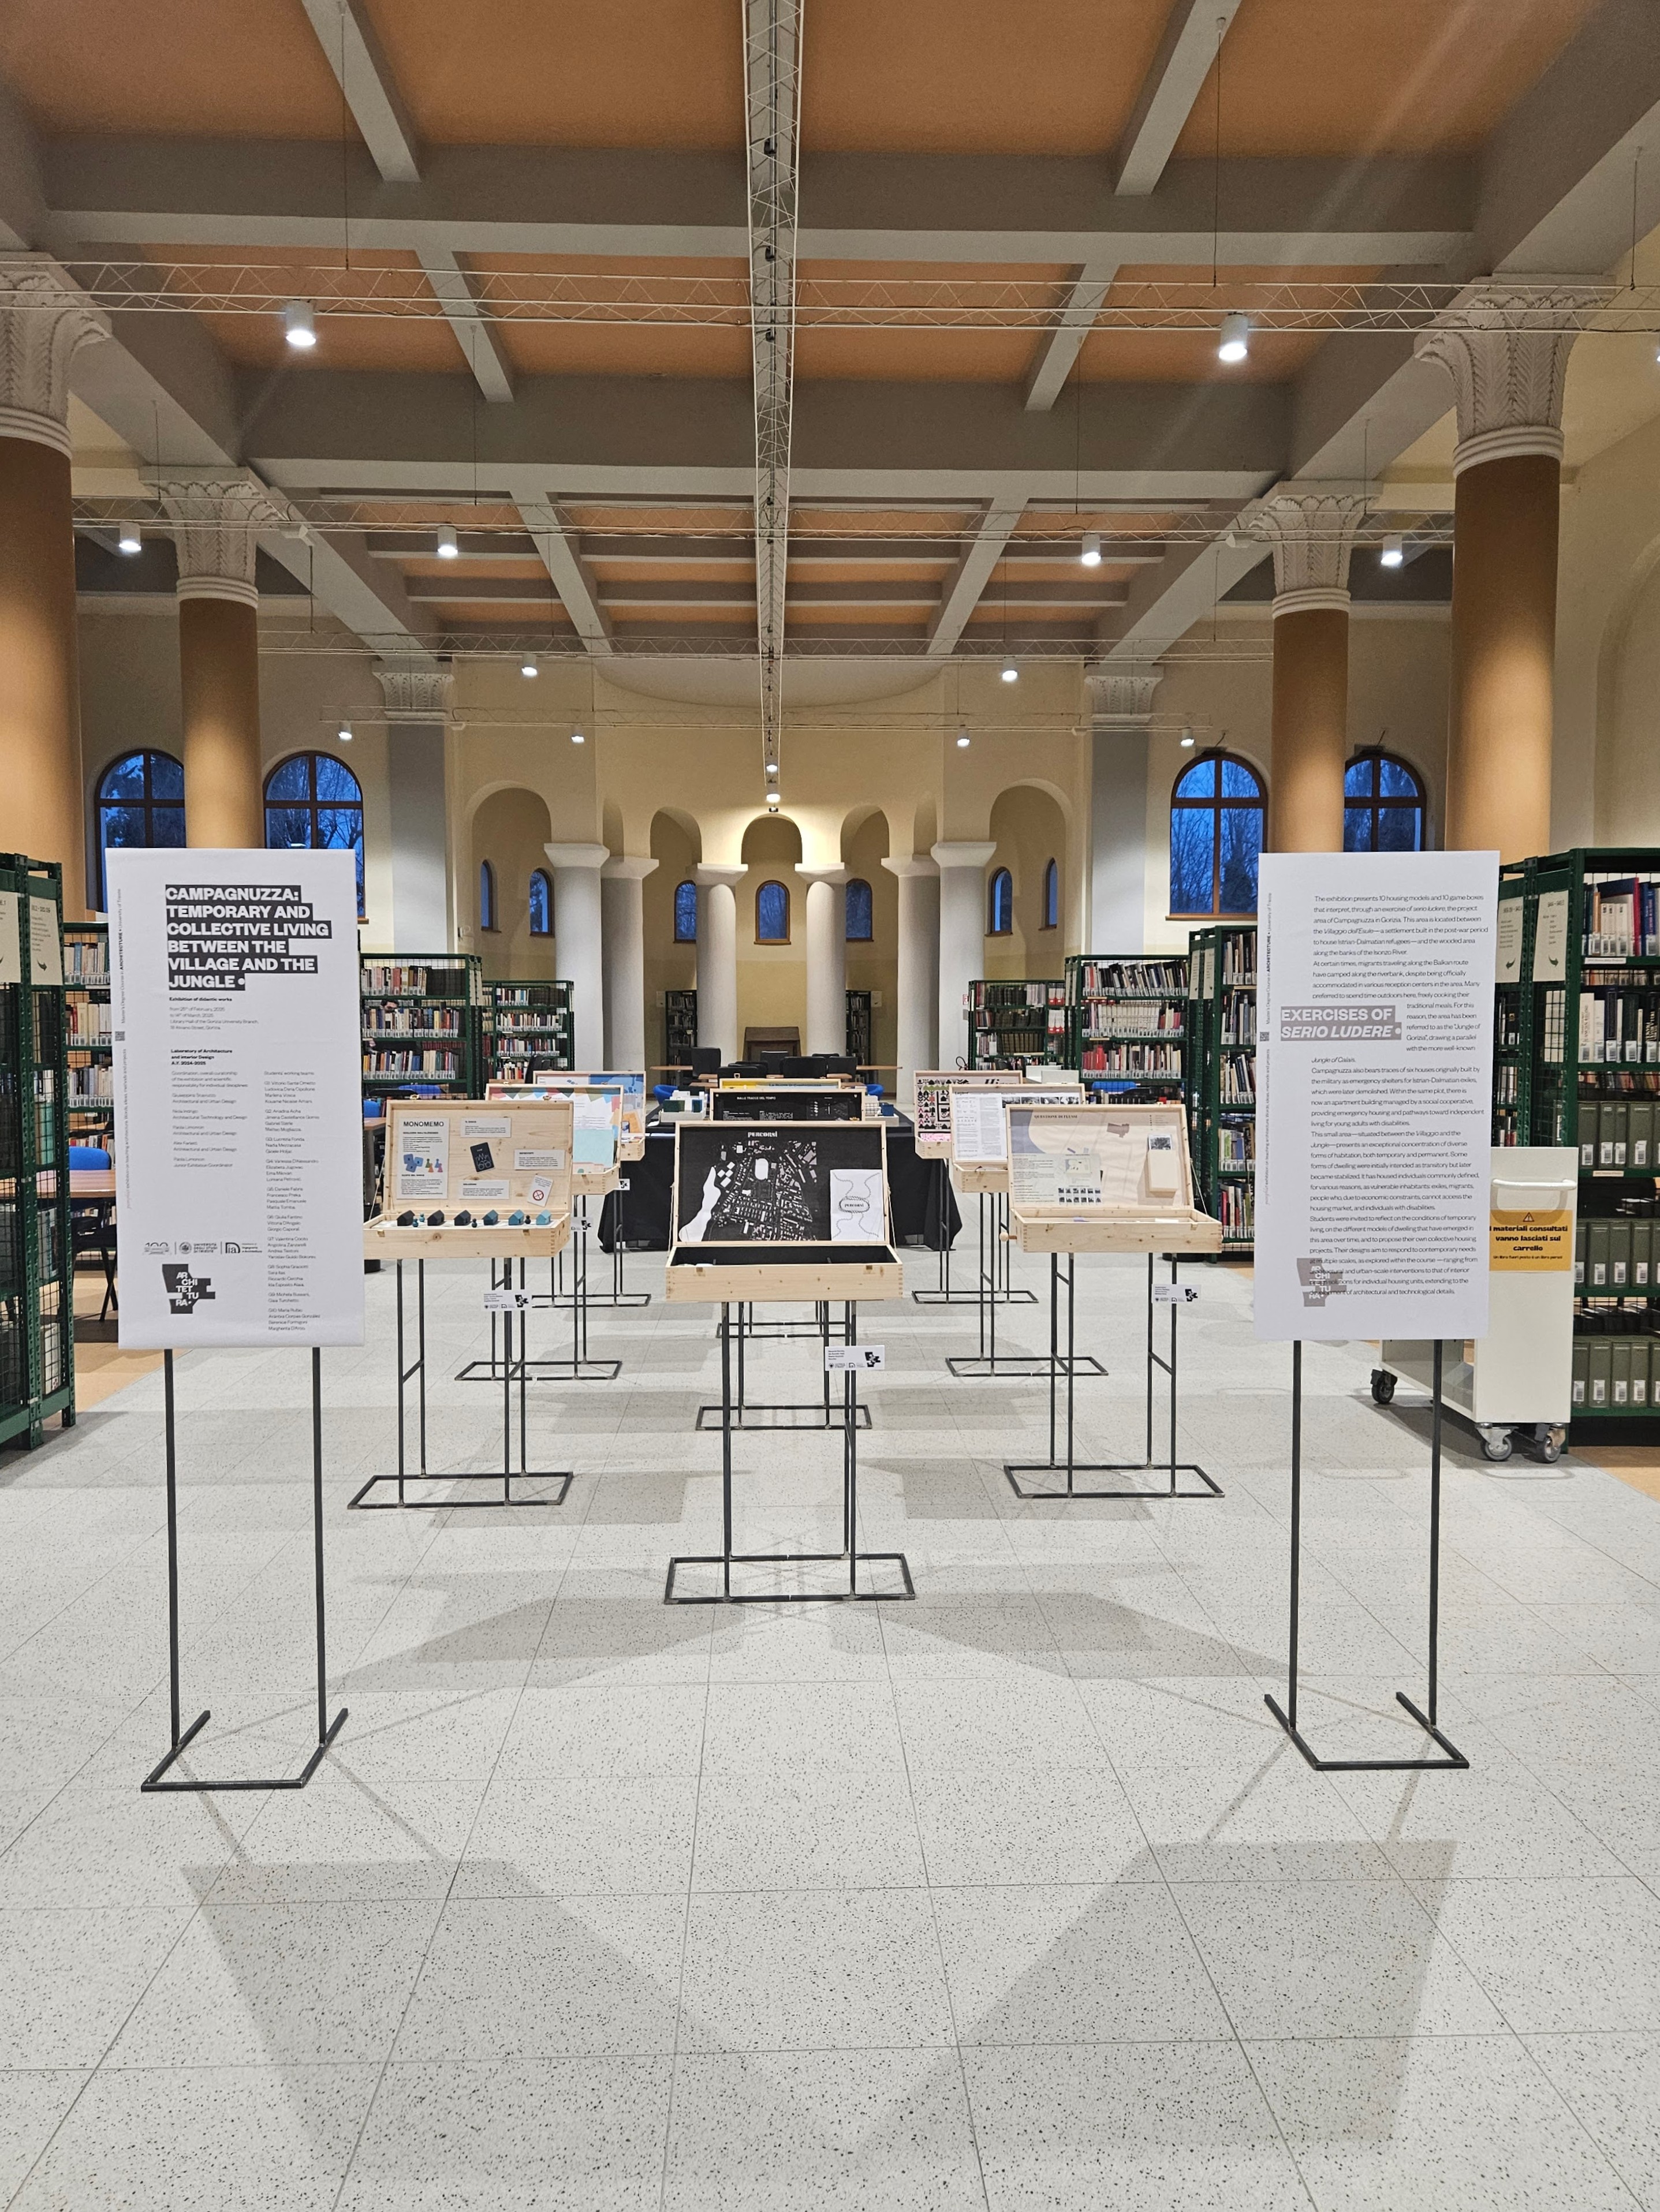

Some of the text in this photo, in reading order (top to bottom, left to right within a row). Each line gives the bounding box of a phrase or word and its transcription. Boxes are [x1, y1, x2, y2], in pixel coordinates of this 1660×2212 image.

[166, 888, 299, 901] CAMPAGNUZZA:
[167, 906, 310, 918] TEMPORARY AND
[167, 923, 329, 936] COLLECTIVE LIVING
[167, 940, 286, 953] BETWEEN THE
[168, 958, 315, 970] VILLAGE AND THE
[169, 976, 235, 988] JUNGLE
[1281, 1008, 1392, 1021] EXERCISES OF
[1281, 1025, 1393, 1038] SERIO LUDERE
